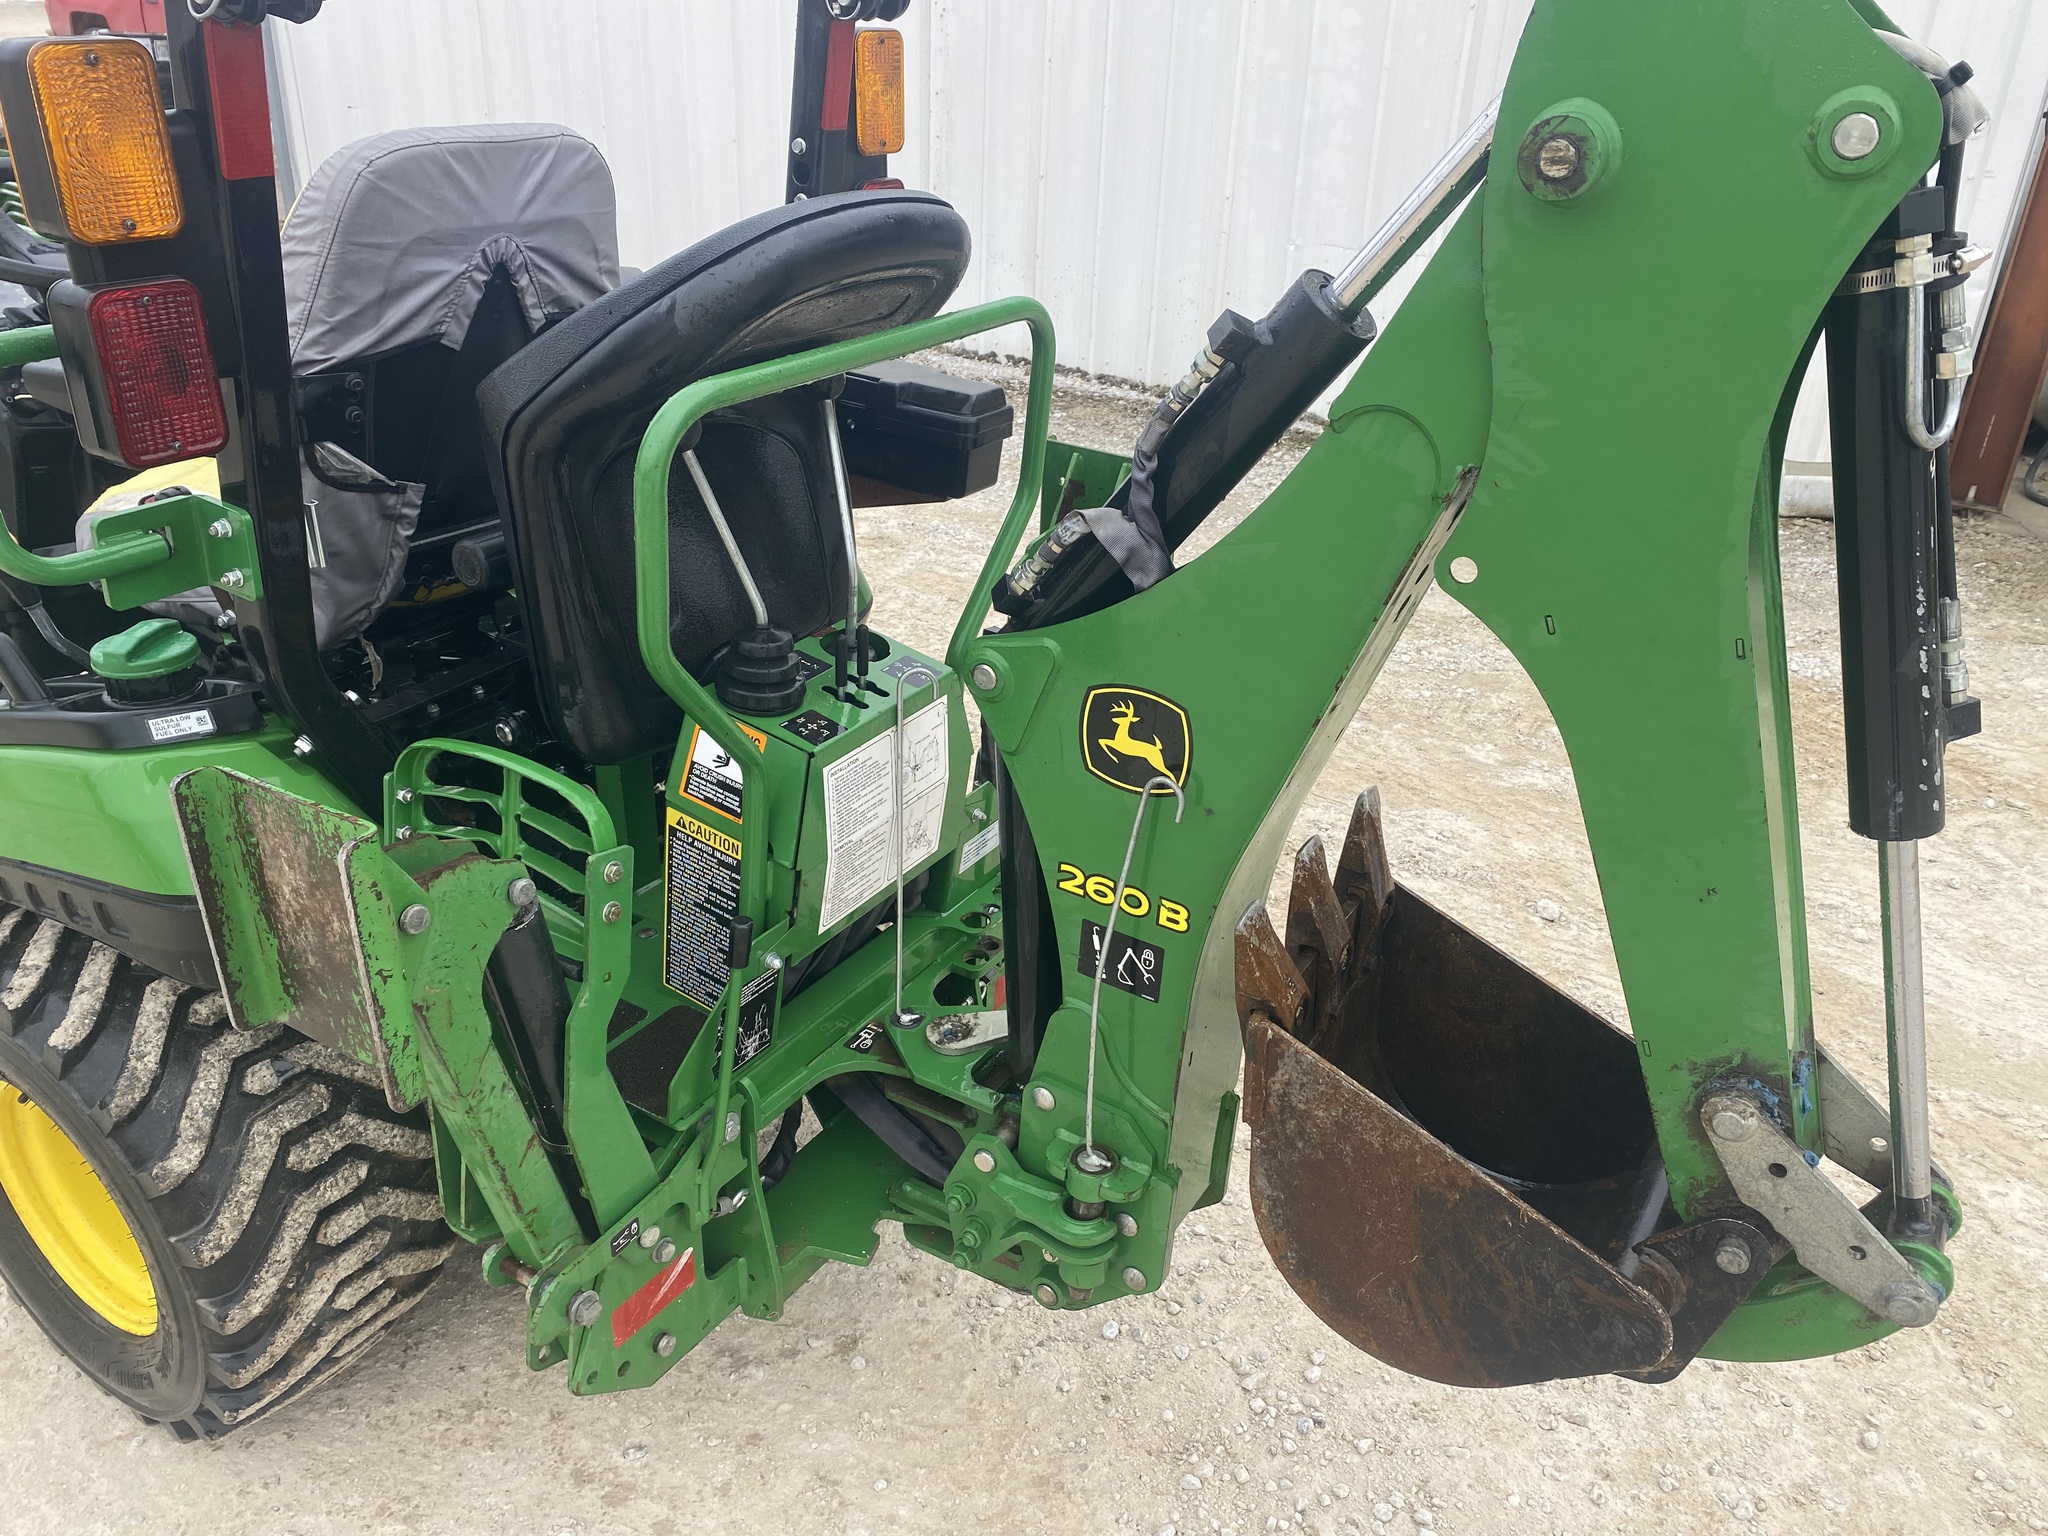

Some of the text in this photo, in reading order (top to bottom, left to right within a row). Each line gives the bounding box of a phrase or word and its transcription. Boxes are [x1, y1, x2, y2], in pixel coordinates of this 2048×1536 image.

[152, 718, 174, 726] ULTRA
[154, 723, 181, 732] SULFUR
[155, 730, 173, 738] FUEL
[692, 768, 717, 783] OR DEATH
[693, 763, 708, 773] AVOID
[709, 770, 726, 782] CRUSH
[831, 757, 859, 777] INSTALLATION
[688, 821, 739, 856] CAUTION
[834, 839, 853, 852] REMOVAL
[676, 831, 737, 867] HELP AVOID INJURY
[1057, 862, 1190, 933] 260 B
